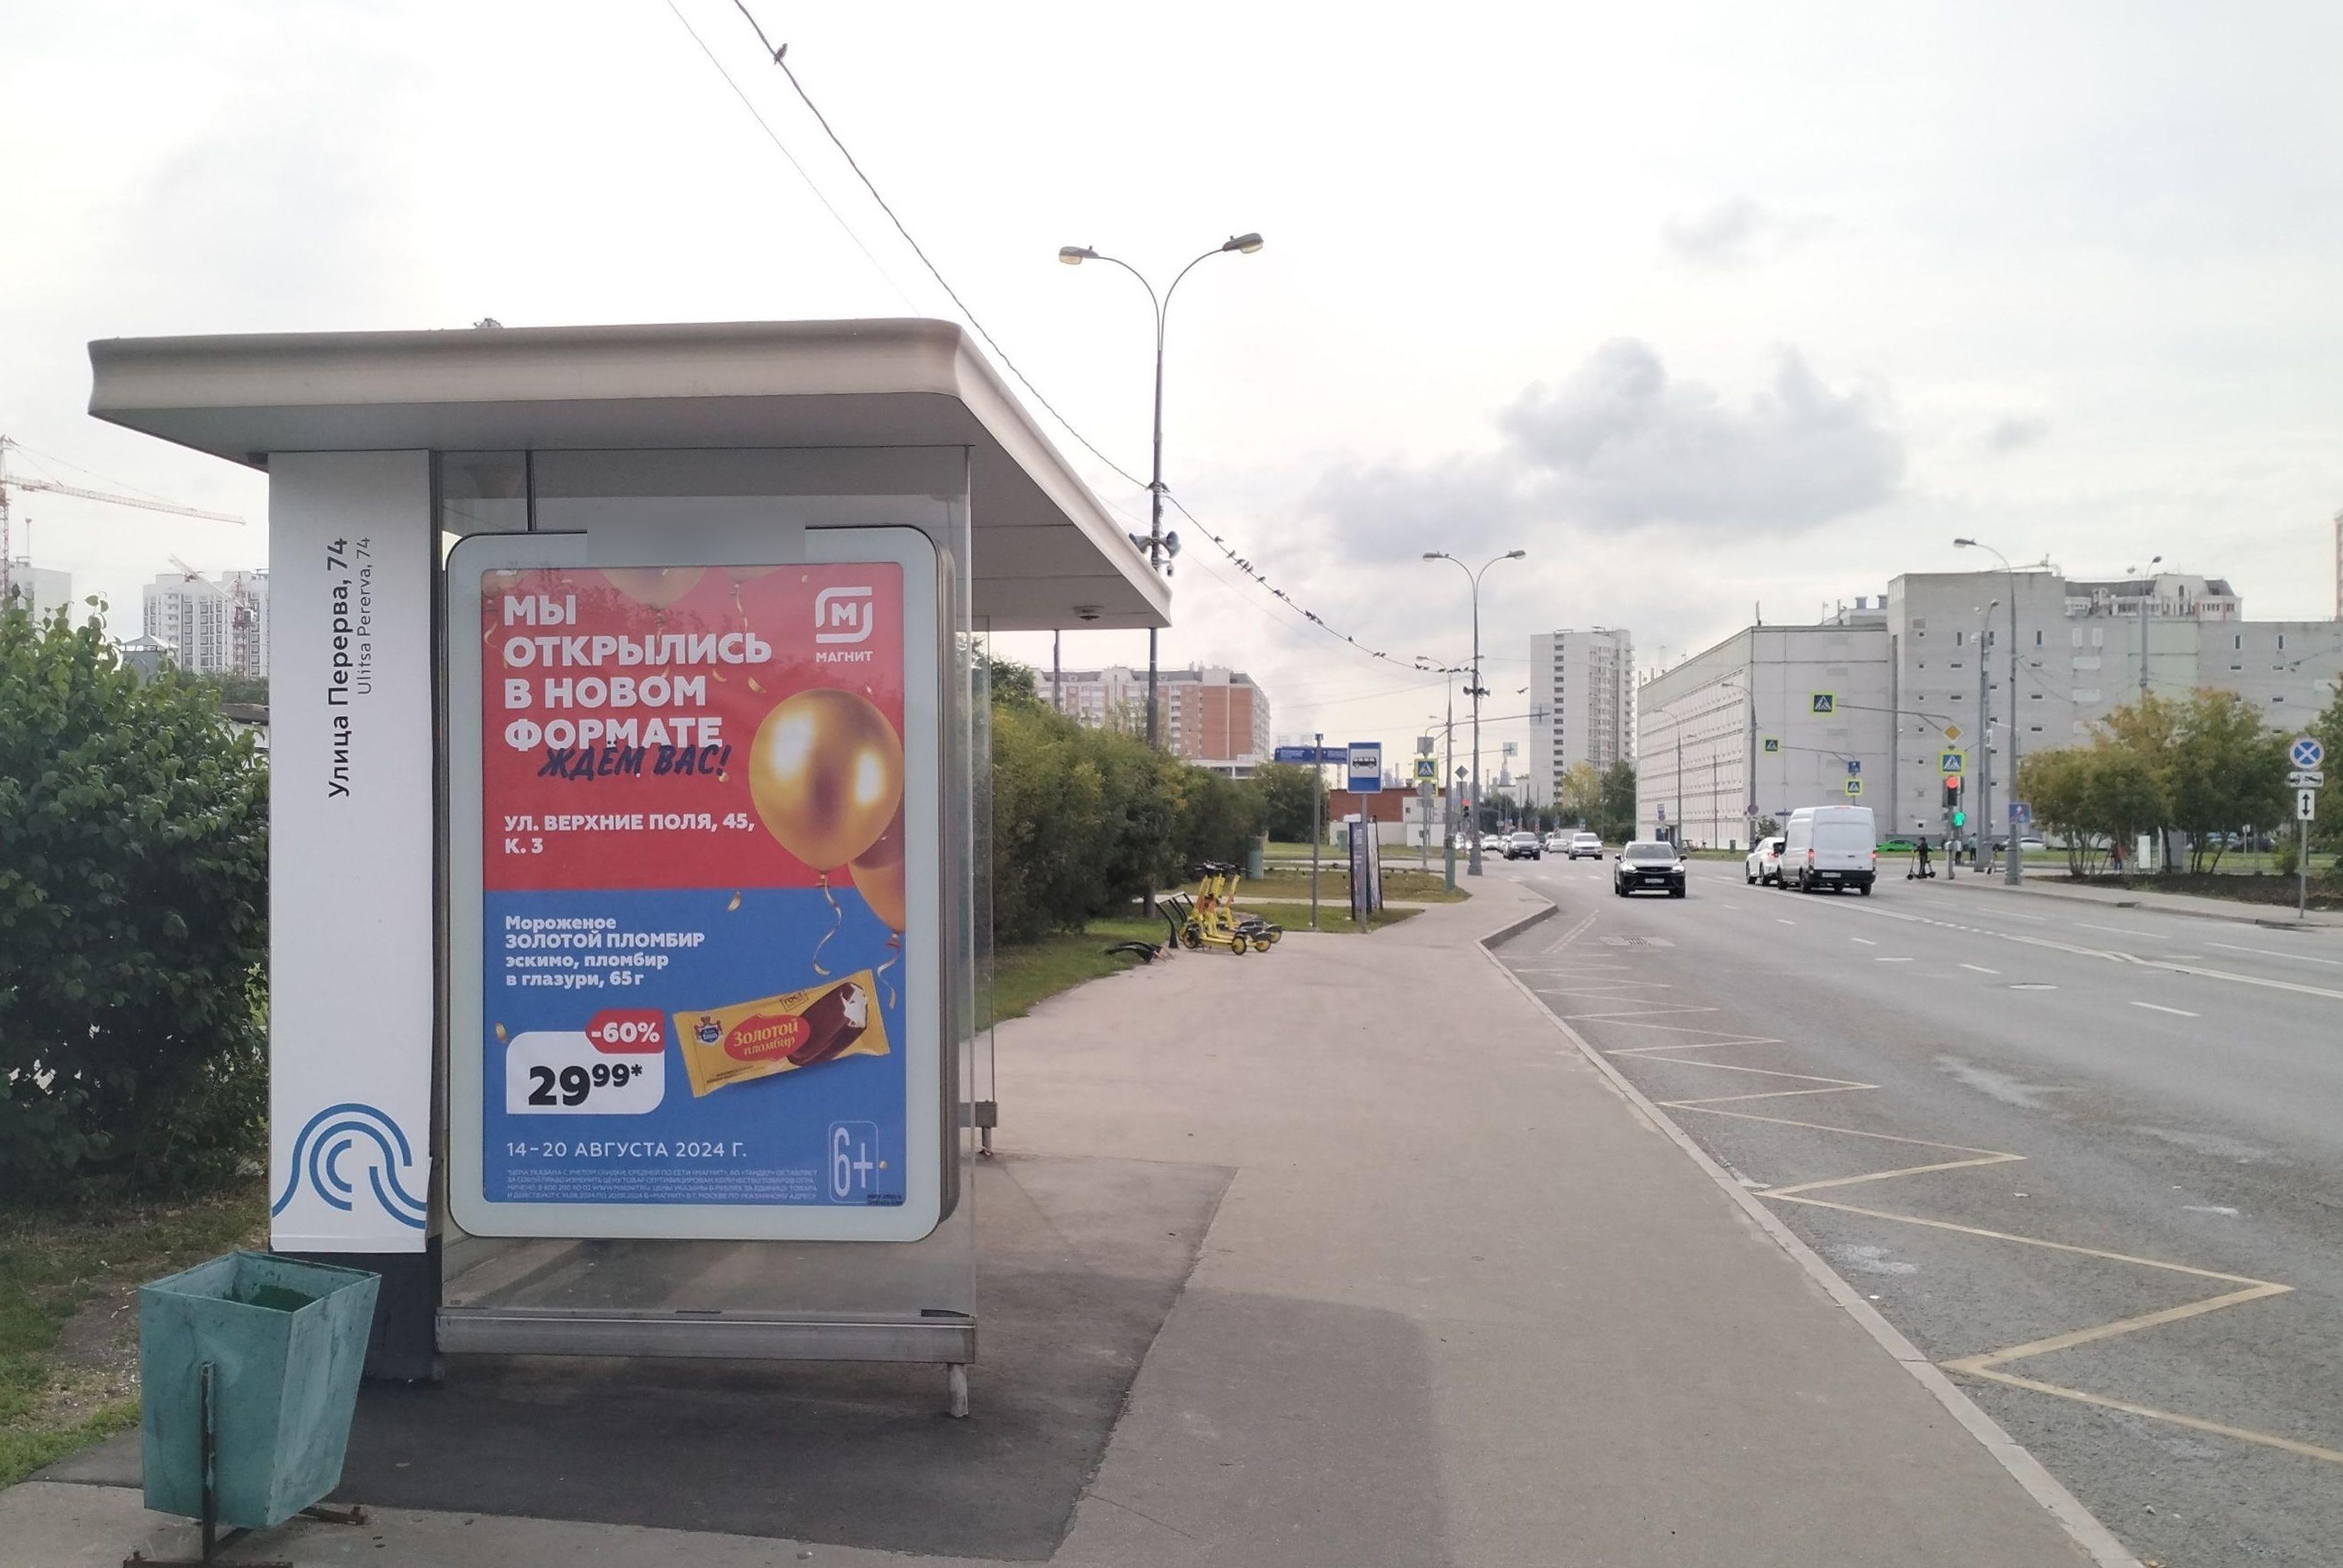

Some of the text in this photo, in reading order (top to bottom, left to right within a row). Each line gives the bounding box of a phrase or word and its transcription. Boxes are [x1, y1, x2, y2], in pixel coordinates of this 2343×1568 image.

[356, 537, 373, 695] Ulitsa Pererva, 74
[503, 596, 577, 626] МЫ
[503, 633, 772, 668] ОТКРЫЛИСЬ
[815, 650, 873, 663] МАГНИТ
[327, 538, 353, 798] Улица Перерва, 74
[504, 676, 706, 709] В НОВОМ
[504, 717, 723, 751] ФОРМАТЕ
[653, 744, 732, 776] ВАС!
[504, 813, 755, 833] УЛ. ВЕРХНИЕ ПОЛЯ, 45,
[504, 839, 543, 854] К. 3
[505, 916, 616, 932] Мороженое
[505, 930, 705, 949] ЗОЛОТОЙ ПЛОМБИР
[505, 953, 669, 971] эскимо, пломбир
[506, 974, 518, 986] в
[522, 973, 604, 988] глазури,
[591, 1022, 660, 1044] -60%
[733, 1017, 799, 1047] Золотой
[744, 1036, 796, 1056] пломбир
[575, 1142, 668, 1158] АВГУСТА
[675, 1142, 725, 1158] 2024
[732, 1142, 747, 1158] Г.
[834, 1126, 874, 1198] 6+
